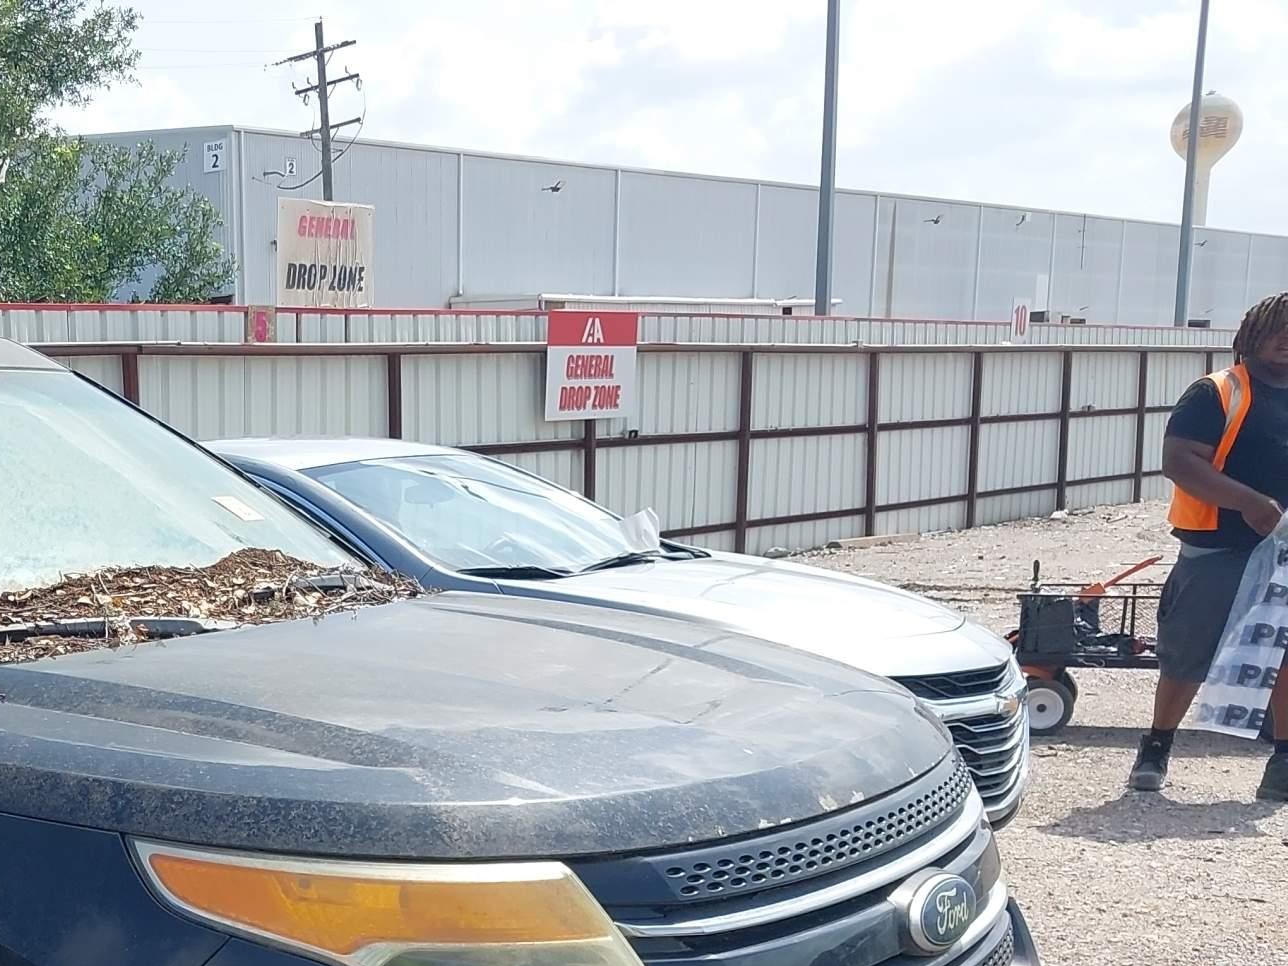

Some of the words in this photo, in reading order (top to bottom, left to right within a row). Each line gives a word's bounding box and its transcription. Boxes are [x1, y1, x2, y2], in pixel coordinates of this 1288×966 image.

[207, 143, 223, 152] BLDG
[212, 153, 219, 168] 2
[288, 162, 295, 174] 2
[298, 215, 356, 240] GENERAL
[286, 262, 327, 291] DROP
[328, 264, 365, 292] ZONE
[1014, 305, 1027, 336] 10
[566, 355, 614, 380] GENERAL
[559, 386, 591, 411] DROP
[592, 385, 621, 410] ZONE
[936, 887, 969, 935] Ford
